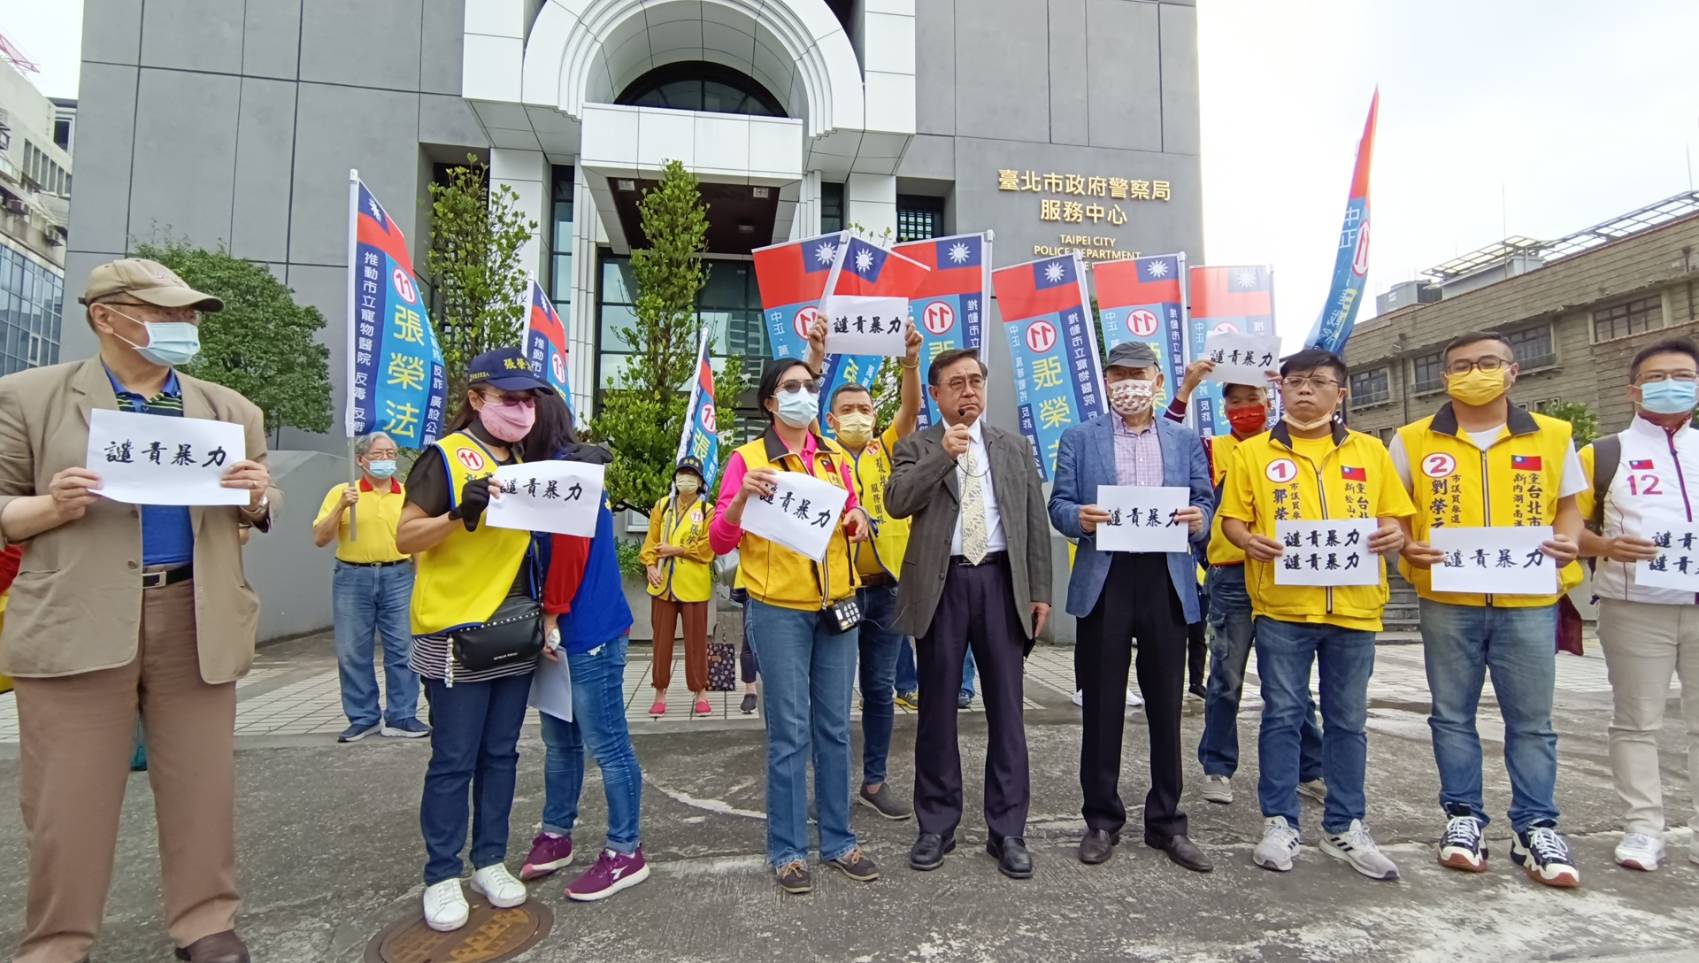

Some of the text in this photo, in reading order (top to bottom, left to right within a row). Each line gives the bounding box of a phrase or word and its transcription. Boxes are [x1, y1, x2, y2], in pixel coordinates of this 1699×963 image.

[998, 169, 1171, 201] 臺北市政府警察局
[1040, 199, 1128, 225] 服務中心
[1034, 245, 1070, 256] POLICE
[1060, 234, 1117, 247] TAIPEI CITY
[394, 270, 414, 301] 11
[357, 252, 379, 366] 推動市立寵物醫院
[832, 315, 902, 335] 譴責暴力
[1211, 348, 1273, 368] 譴責暴力
[383, 304, 426, 439] 張榮法
[104, 438, 227, 467] 譴責暴力
[458, 449, 482, 468] 11
[1269, 461, 1288, 480] 1
[1426, 455, 1449, 475] 2
[500, 477, 584, 502] 譴責暴力
[1626, 474, 1663, 495] 12
[1106, 507, 1180, 528] 譴責暴力
[1283, 528, 1360, 548] 譴責暴力
[1283, 552, 1360, 571] 譴責暴力
[1443, 548, 1545, 568] 譴責暴力
[1648, 554, 1699, 575] 譴責
